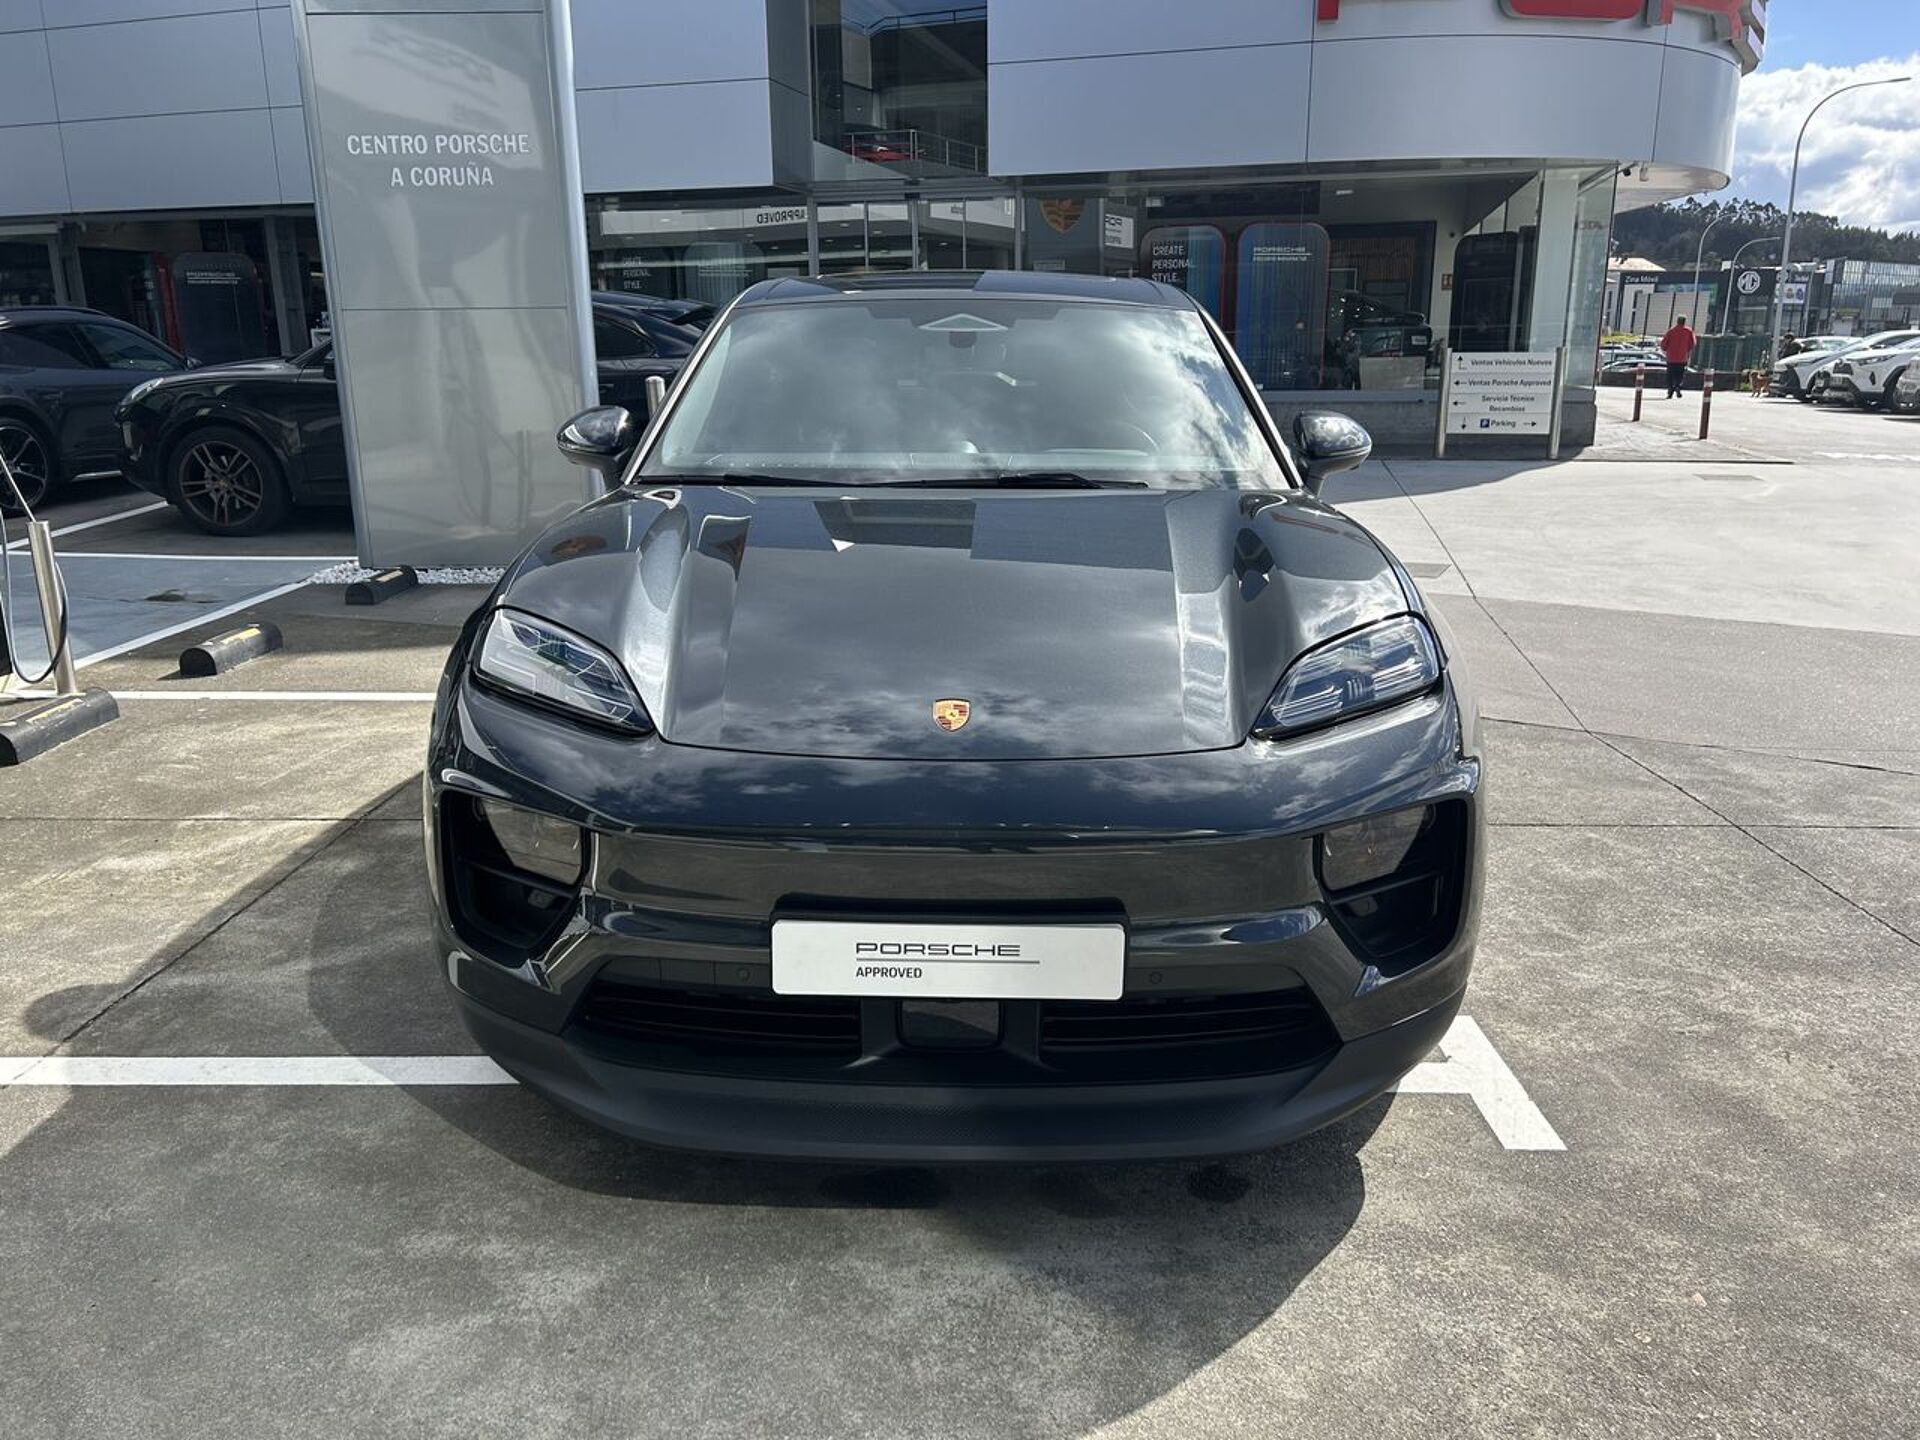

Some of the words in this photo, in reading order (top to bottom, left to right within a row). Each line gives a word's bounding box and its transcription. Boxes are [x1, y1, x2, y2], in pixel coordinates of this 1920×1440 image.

[347, 134, 428, 155] CENTRO
[435, 133, 529, 154] PORSCHE
[391, 167, 404, 187] A
[410, 161, 494, 187] CORUÑA
[1152, 245, 1185, 256] CREATE
[1520, 379, 1552, 387] Approved
[1490, 419, 1517, 428] Parking
[855, 942, 1021, 957] PORSCHE
[855, 966, 923, 979] APPROVED
